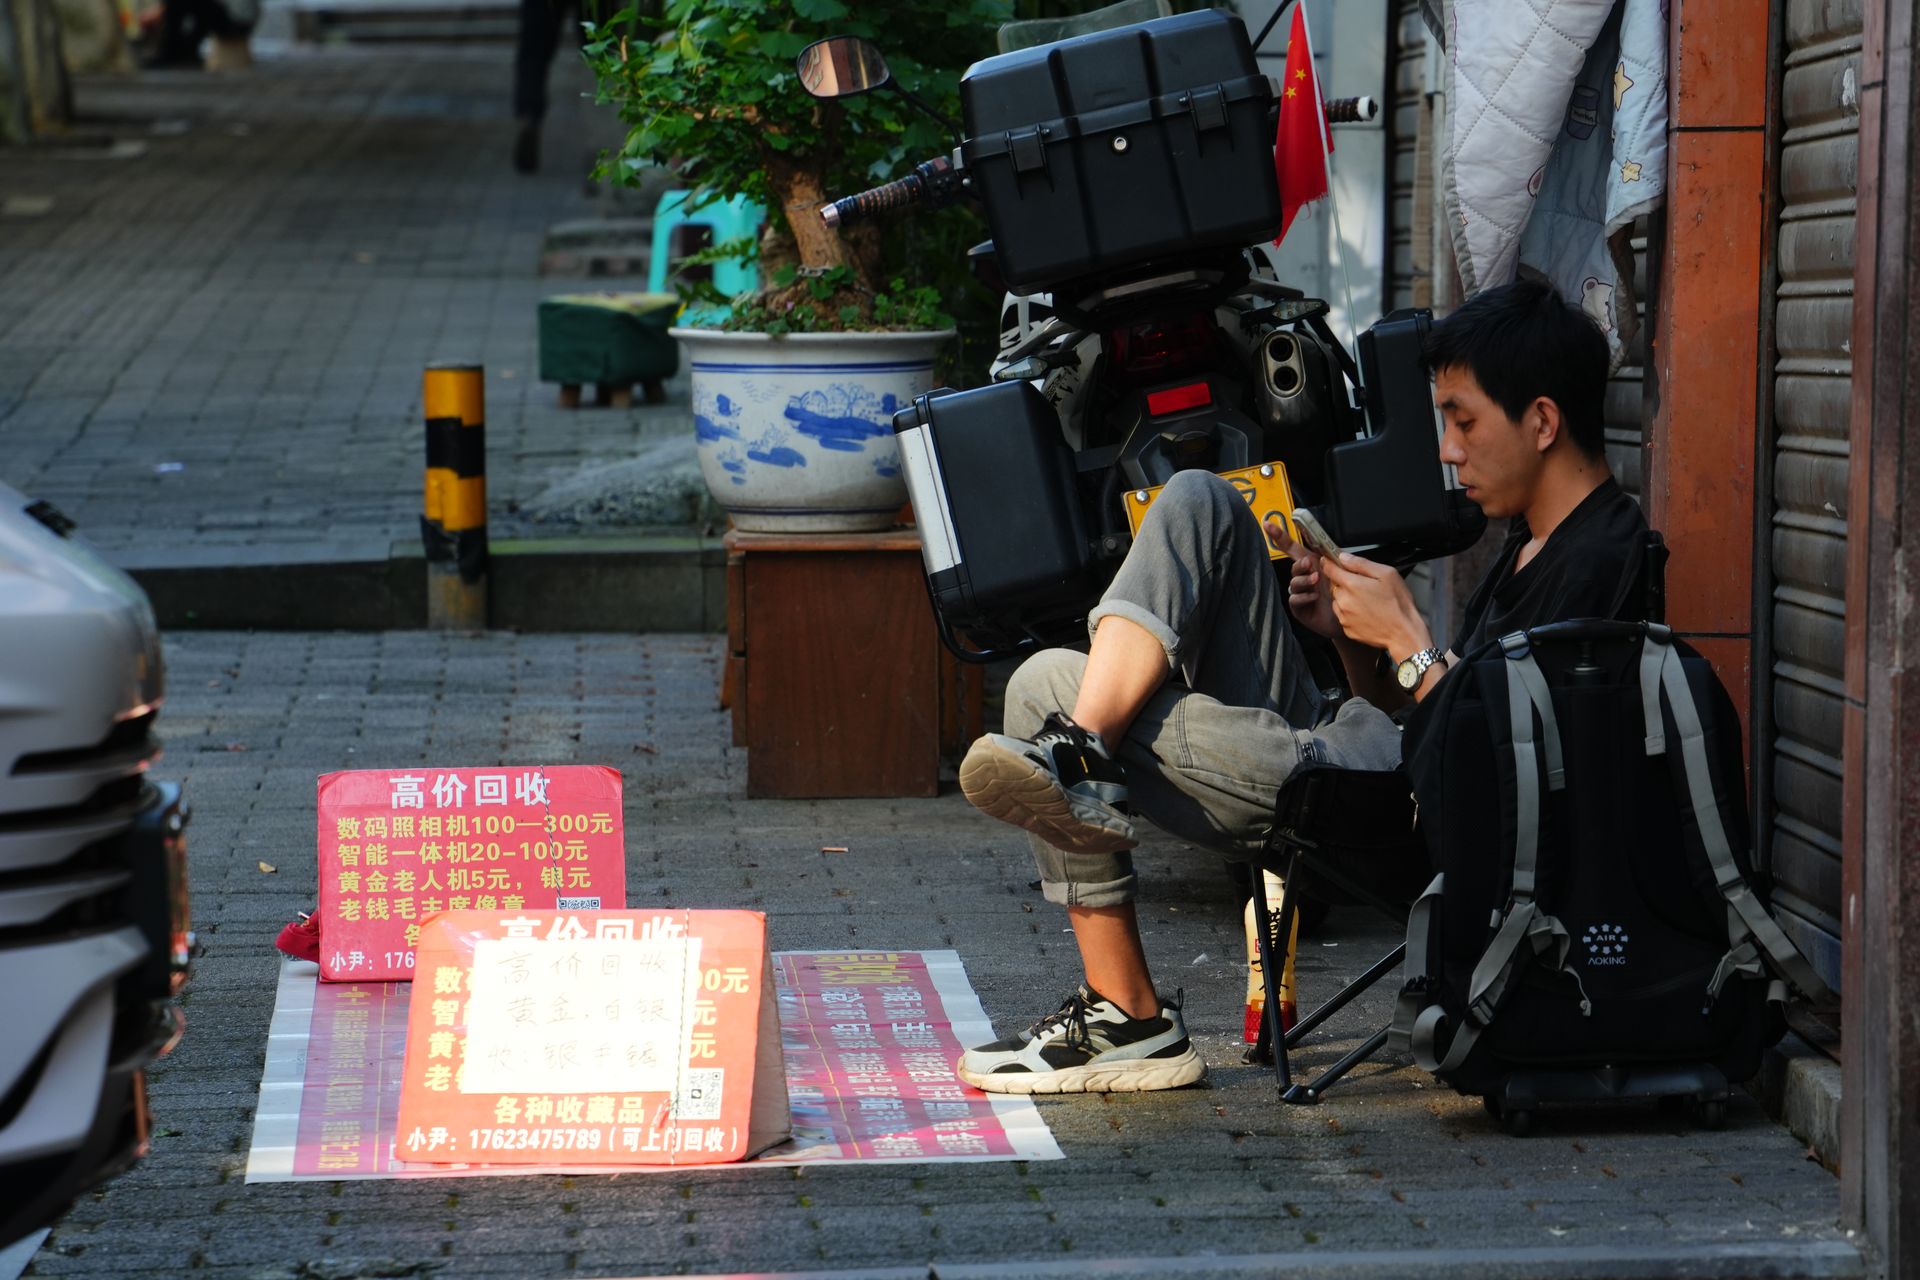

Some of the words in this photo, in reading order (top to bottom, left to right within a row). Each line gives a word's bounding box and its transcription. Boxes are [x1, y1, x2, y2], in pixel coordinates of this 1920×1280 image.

[389, 771, 552, 809] 高价回收
[1596, 934, 1616, 942] AIR
[497, 950, 670, 984] 高价回收
[1587, 956, 1626, 966] AOKING
[494, 1095, 646, 1124] 各种收藏品
